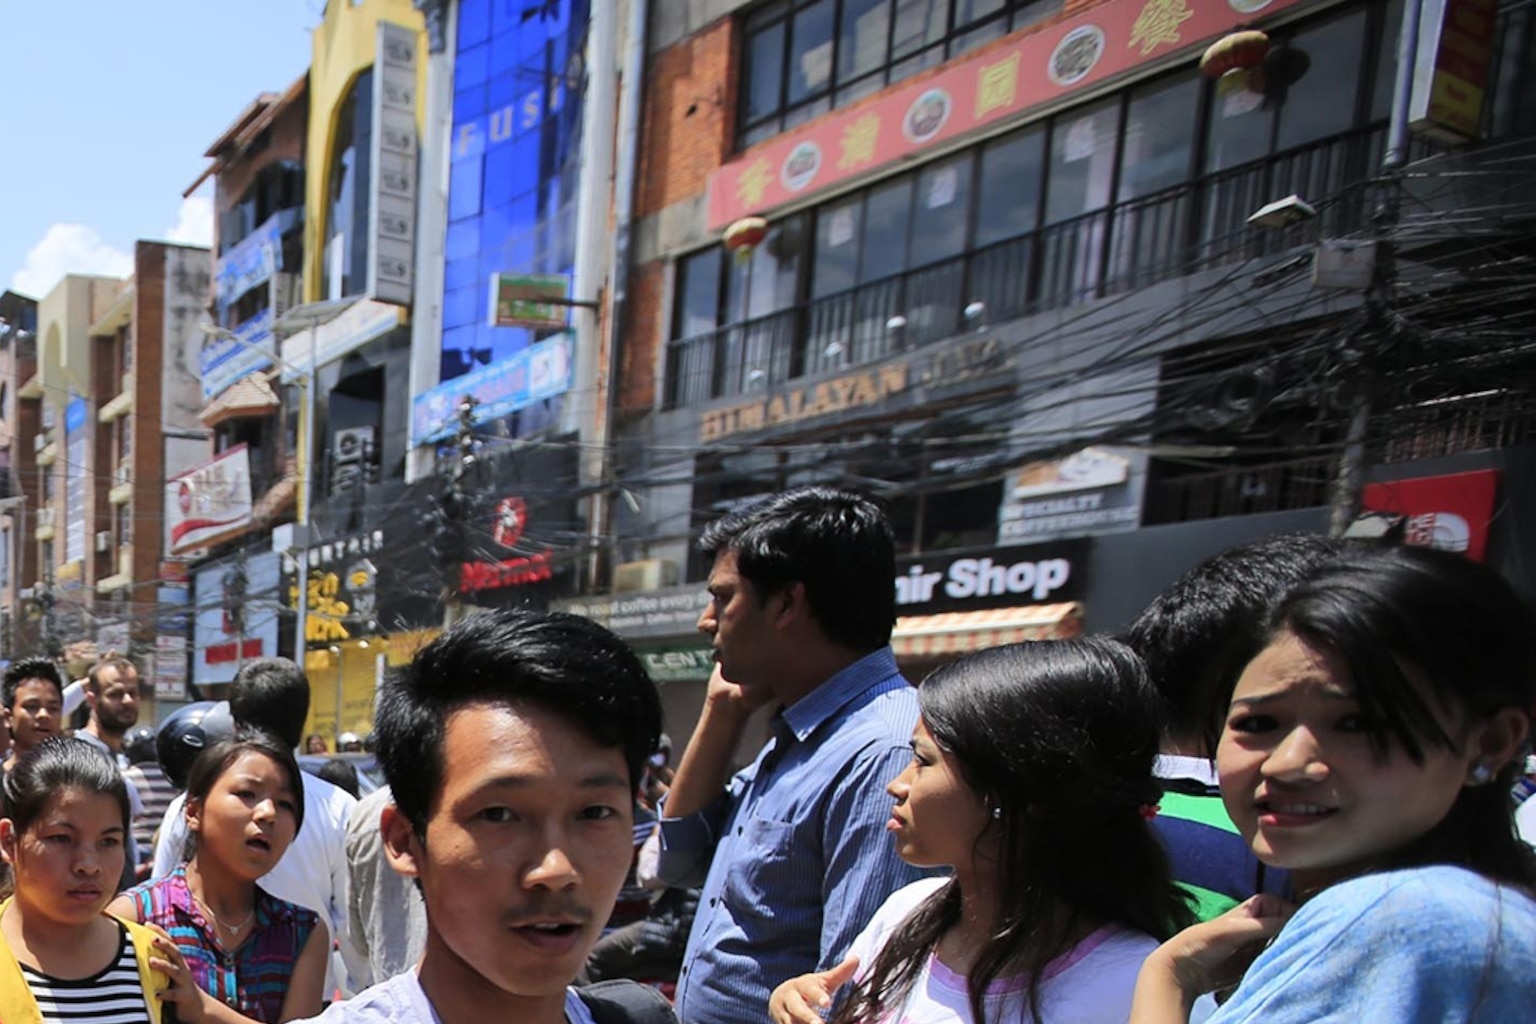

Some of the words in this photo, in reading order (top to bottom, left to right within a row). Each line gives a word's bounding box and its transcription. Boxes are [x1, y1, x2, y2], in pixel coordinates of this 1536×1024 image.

[701, 362, 909, 442] HIMALAYAN
[945, 556, 1071, 600] Shop
[621, 596, 658, 613] coffee
